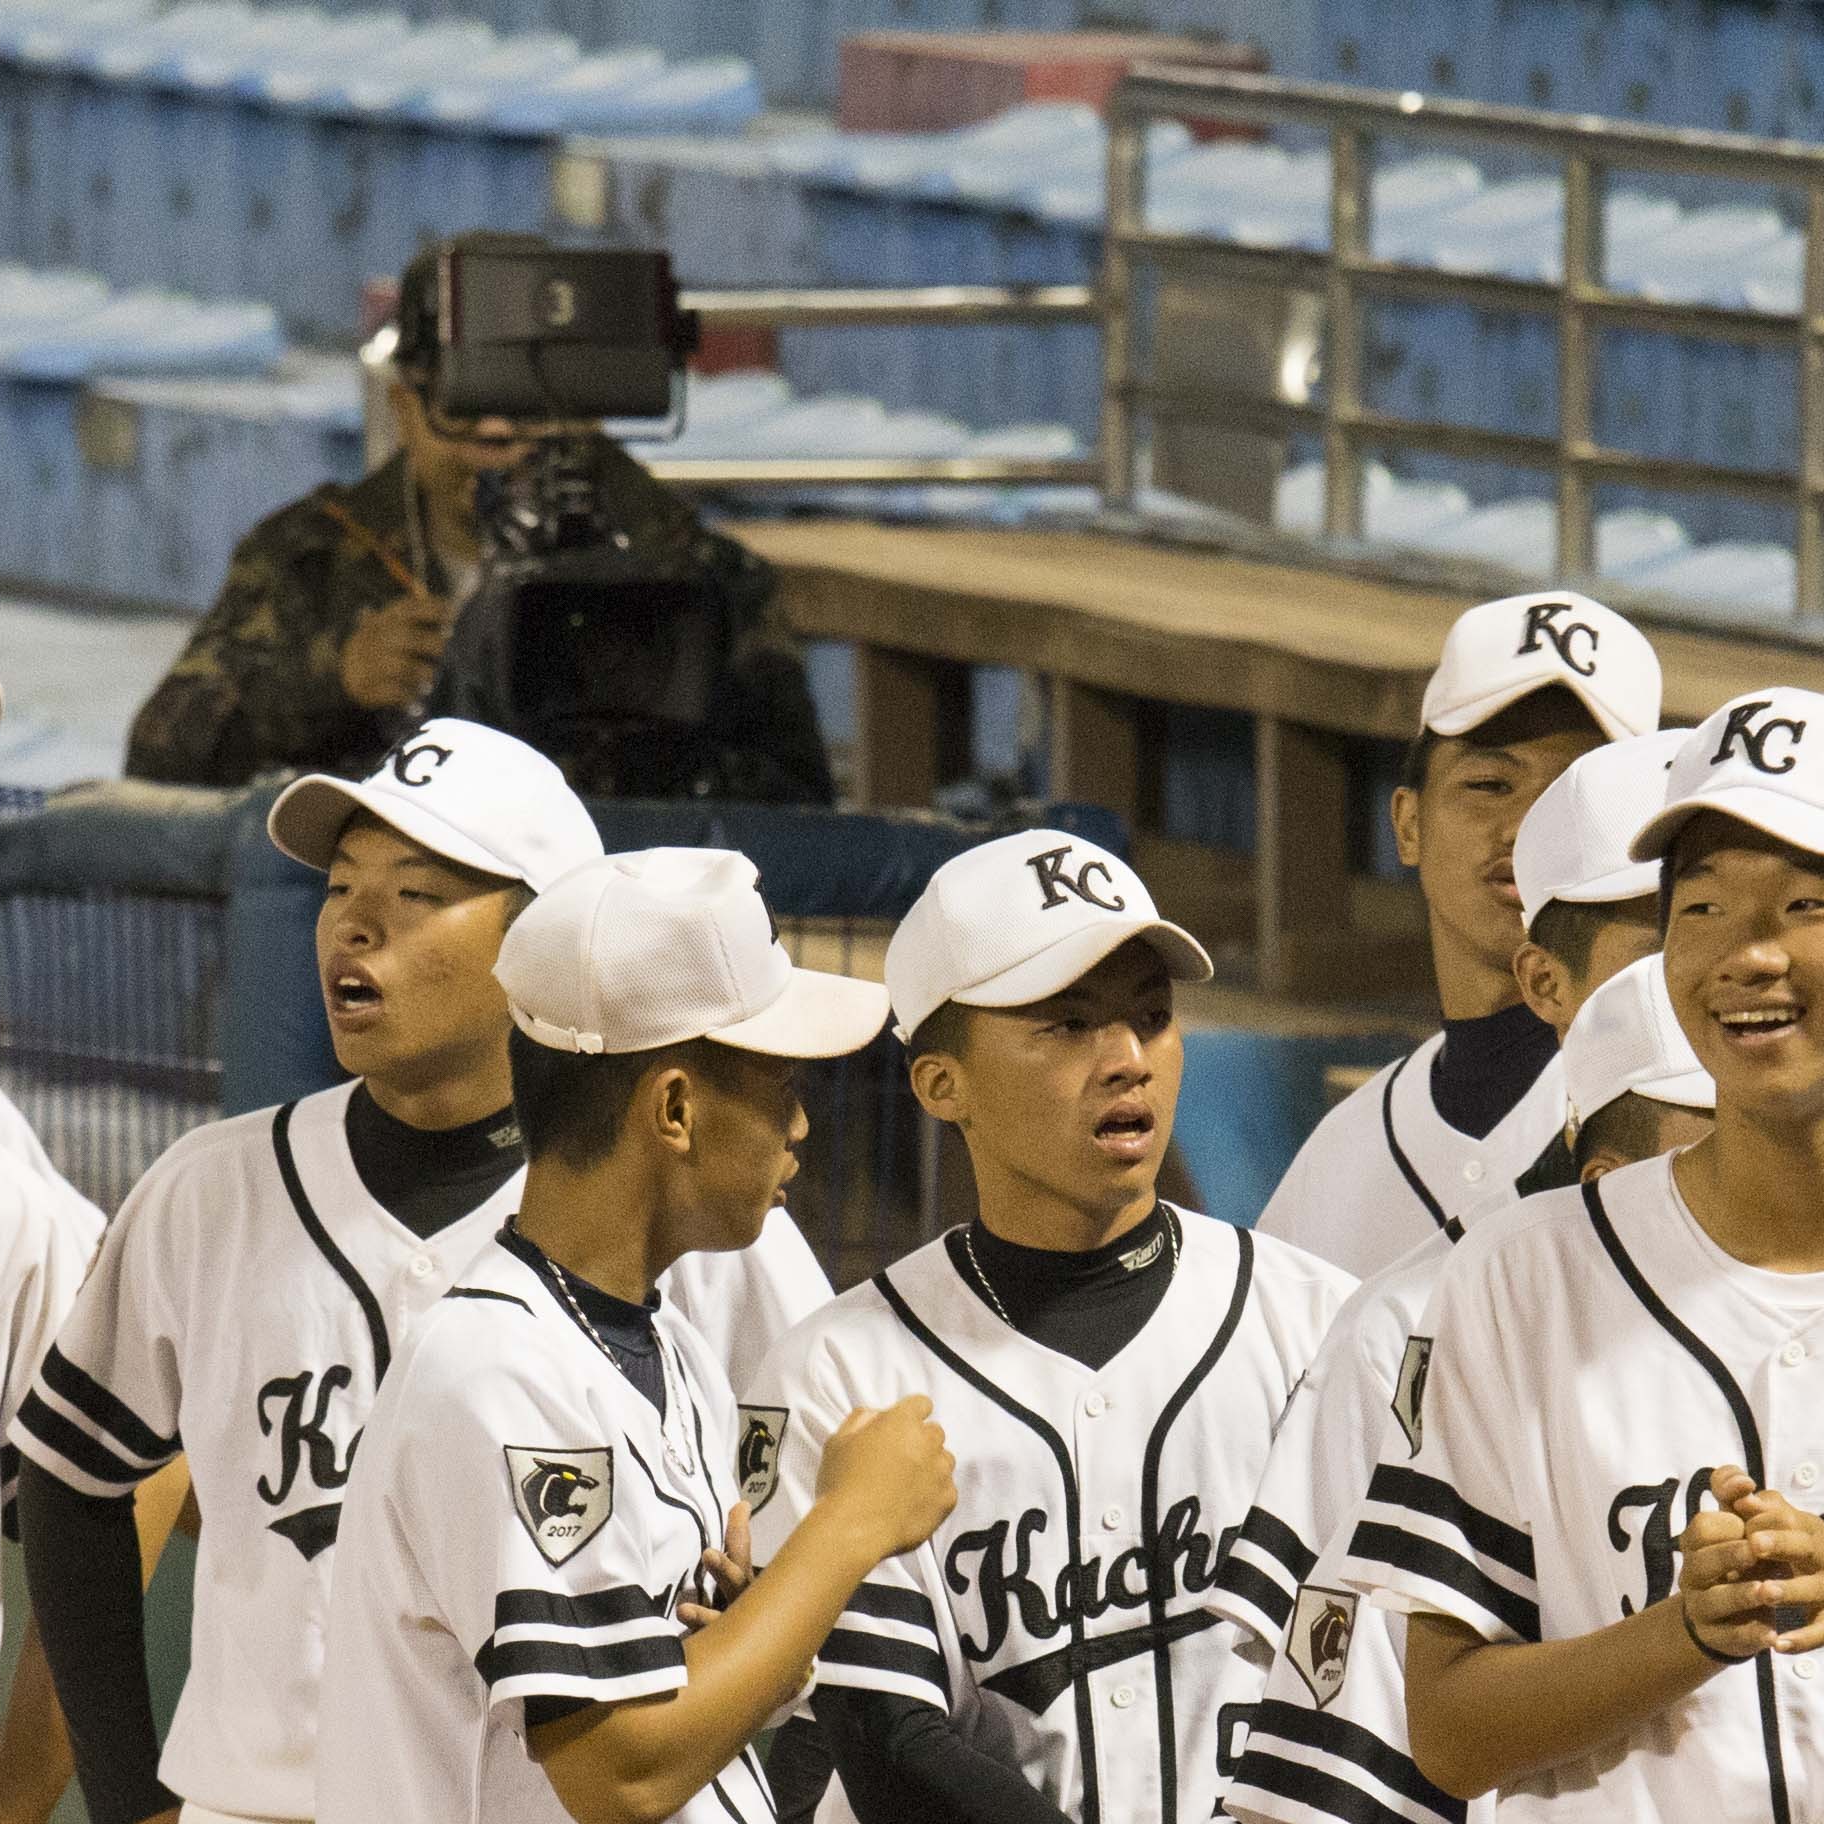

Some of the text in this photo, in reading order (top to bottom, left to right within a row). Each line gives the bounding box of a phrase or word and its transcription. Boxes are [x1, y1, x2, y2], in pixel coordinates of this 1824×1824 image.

[1517, 603, 1600, 676] KC
[1710, 701, 1807, 775] KC
[1026, 845, 1124, 913] KC
[547, 1525, 583, 1538] 2017
